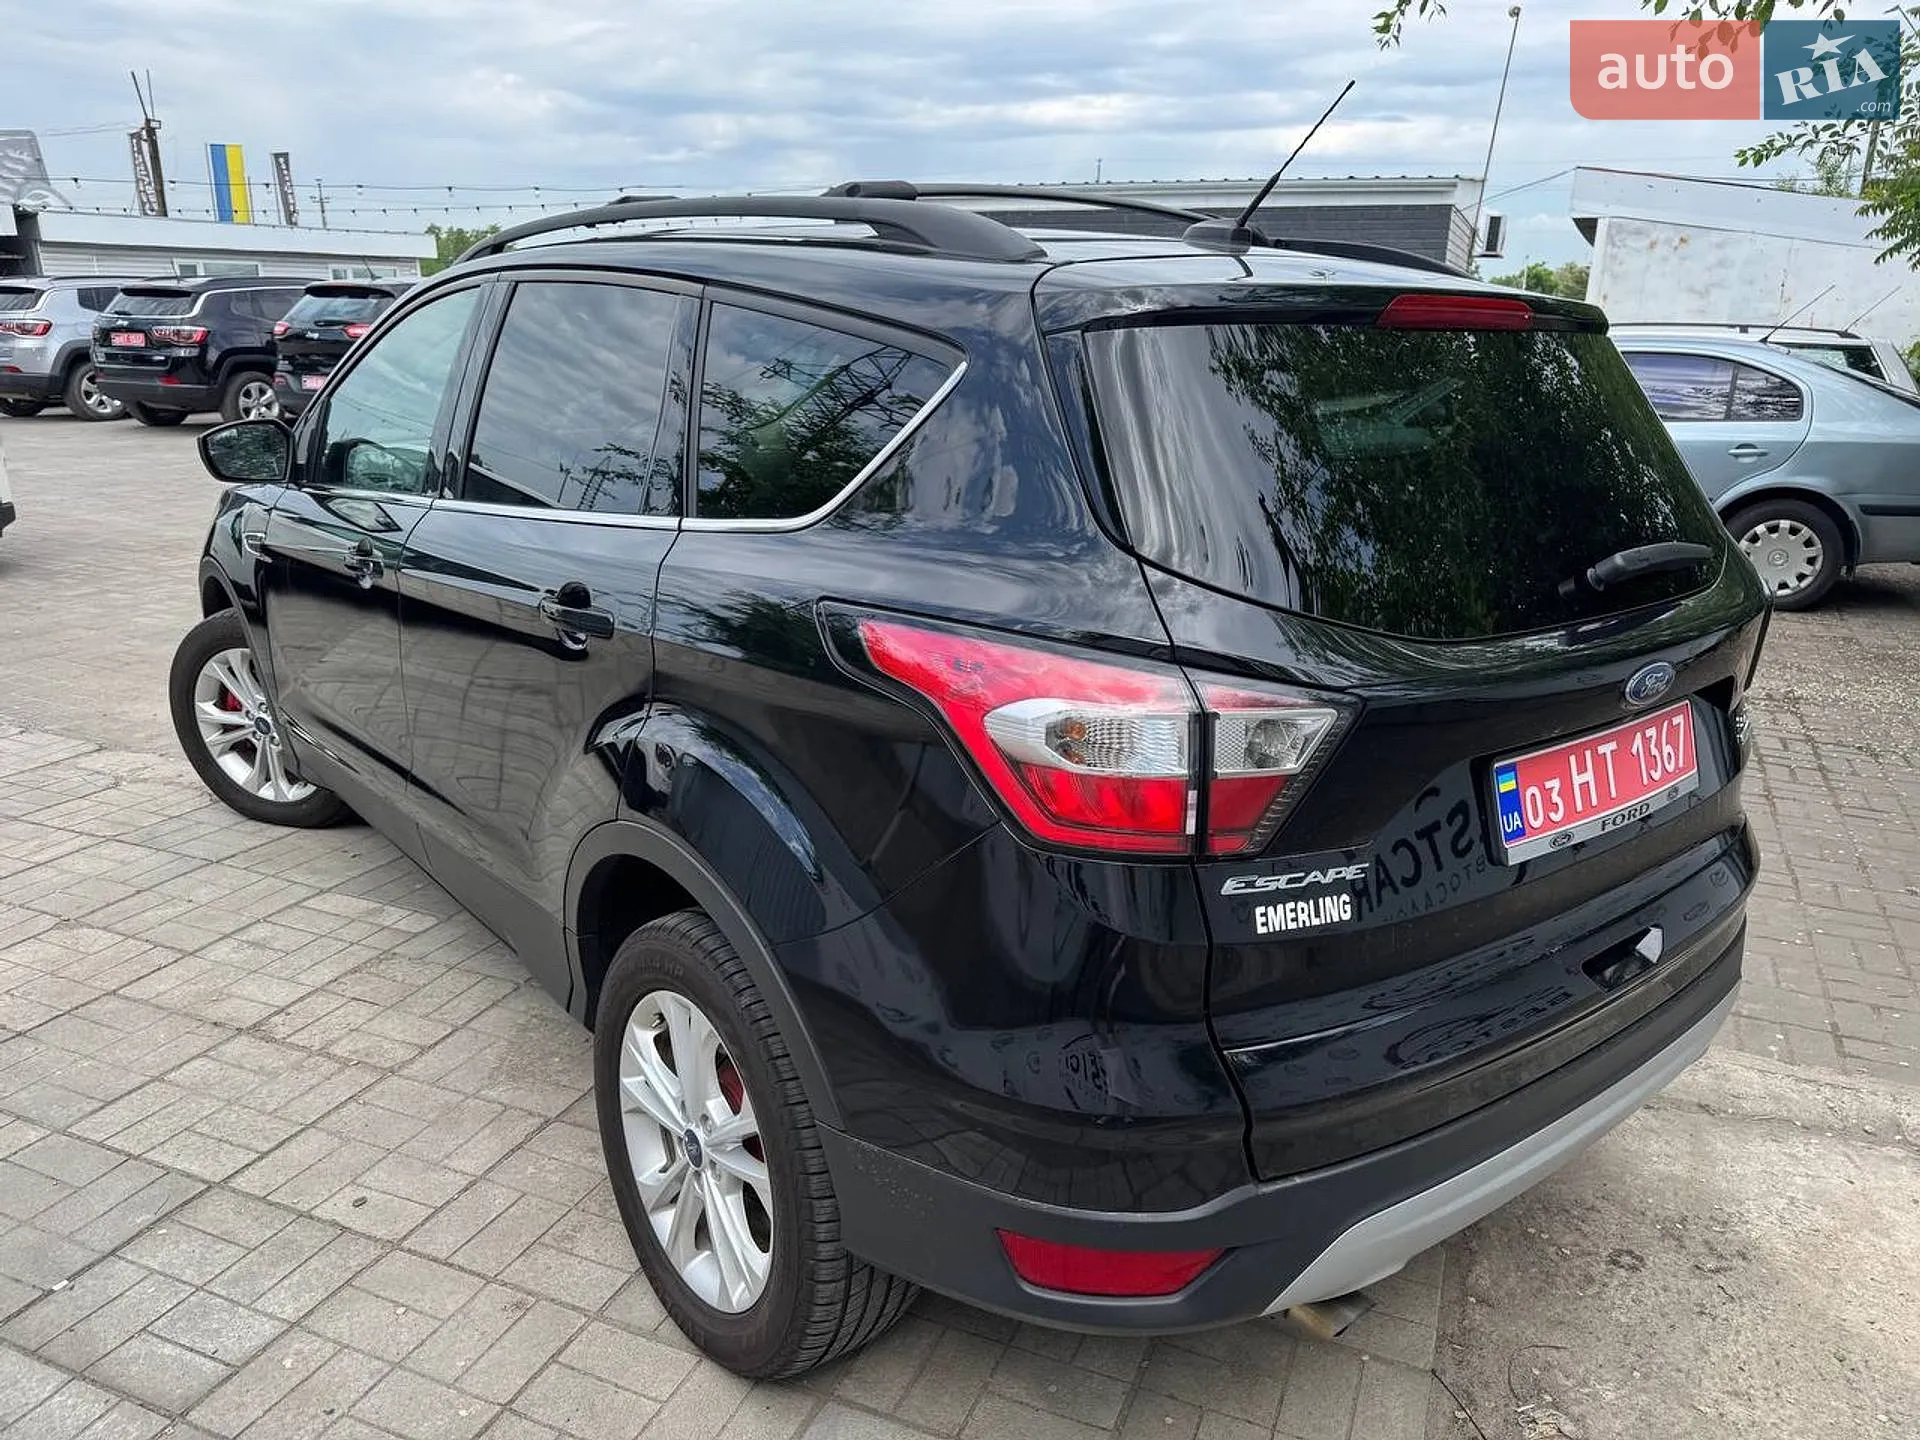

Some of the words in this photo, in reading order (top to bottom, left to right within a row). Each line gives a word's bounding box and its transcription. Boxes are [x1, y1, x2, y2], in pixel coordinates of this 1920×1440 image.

[1525, 778, 1565, 829] 03
[1569, 741, 1618, 813] HT
[1631, 714, 1686, 786] 1367
[1502, 813, 1523, 833] UA
[1601, 802, 1651, 832] FORD
[1220, 863, 1370, 896] ESCAPE
[1255, 893, 1352, 934] EMERLING
